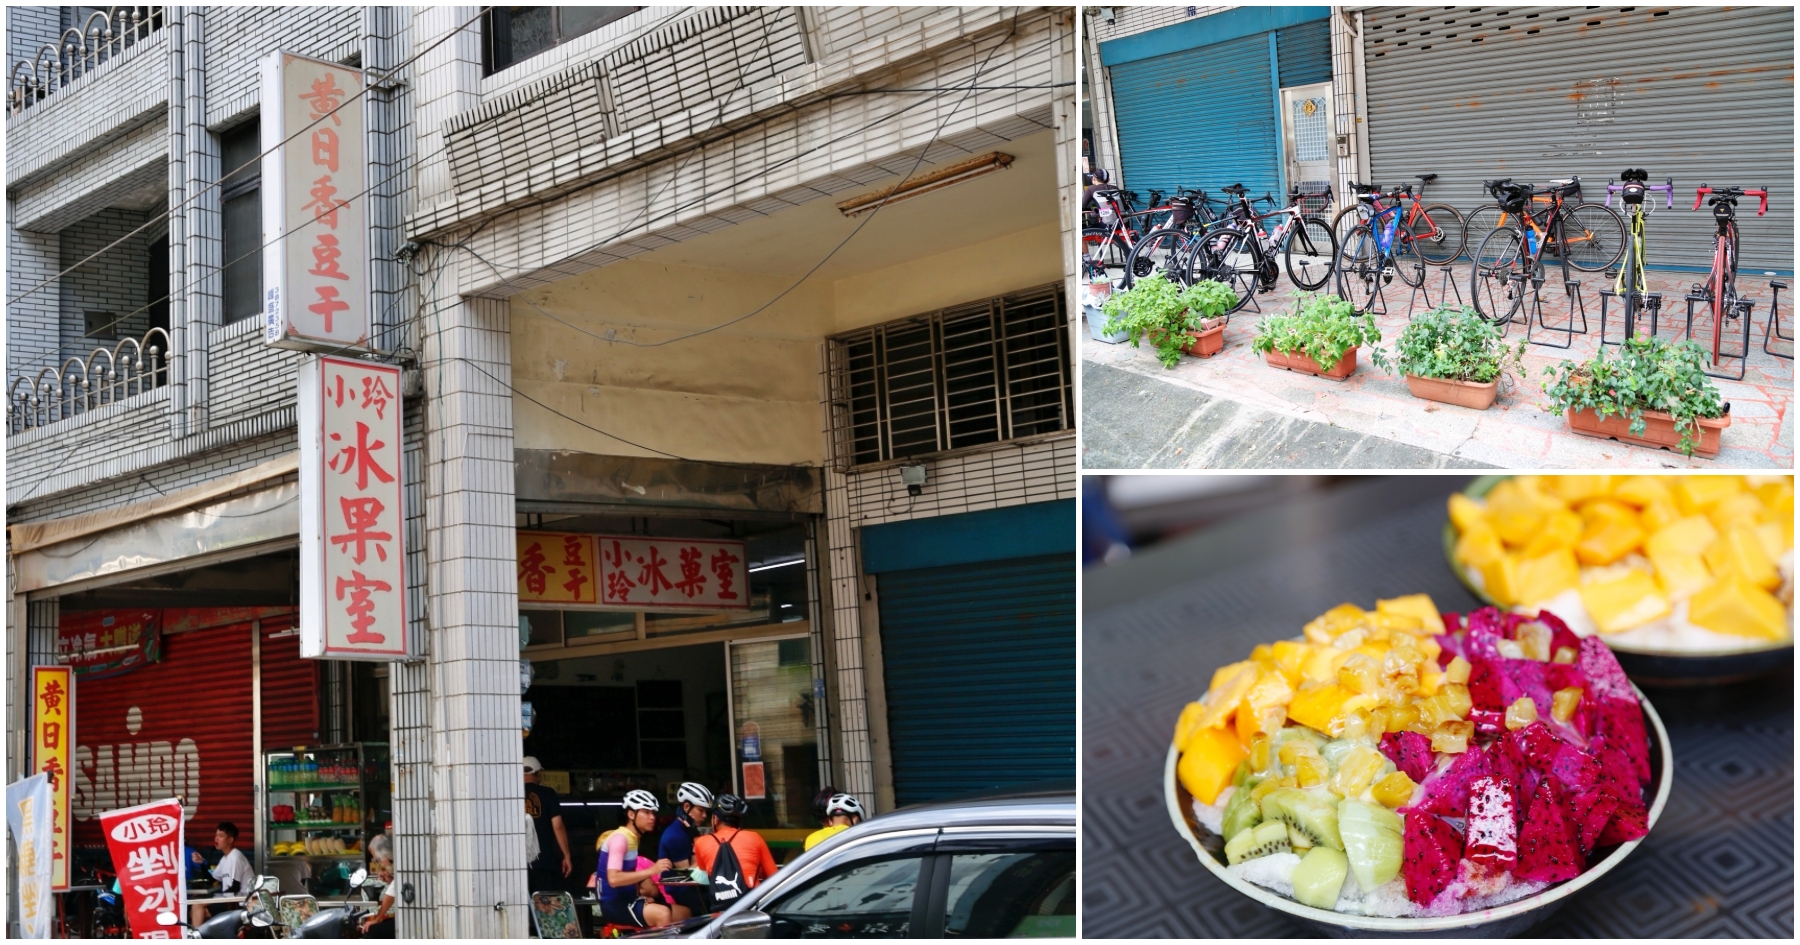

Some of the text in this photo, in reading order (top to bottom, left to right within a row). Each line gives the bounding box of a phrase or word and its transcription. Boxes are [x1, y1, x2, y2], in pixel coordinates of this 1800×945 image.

[298, 72, 350, 333] 黃日香豆干
[327, 374, 395, 420] 小玲
[328, 421, 396, 644] 冰果室
[123, 816, 171, 840] 小玲
[127, 841, 179, 938] 剉冰
